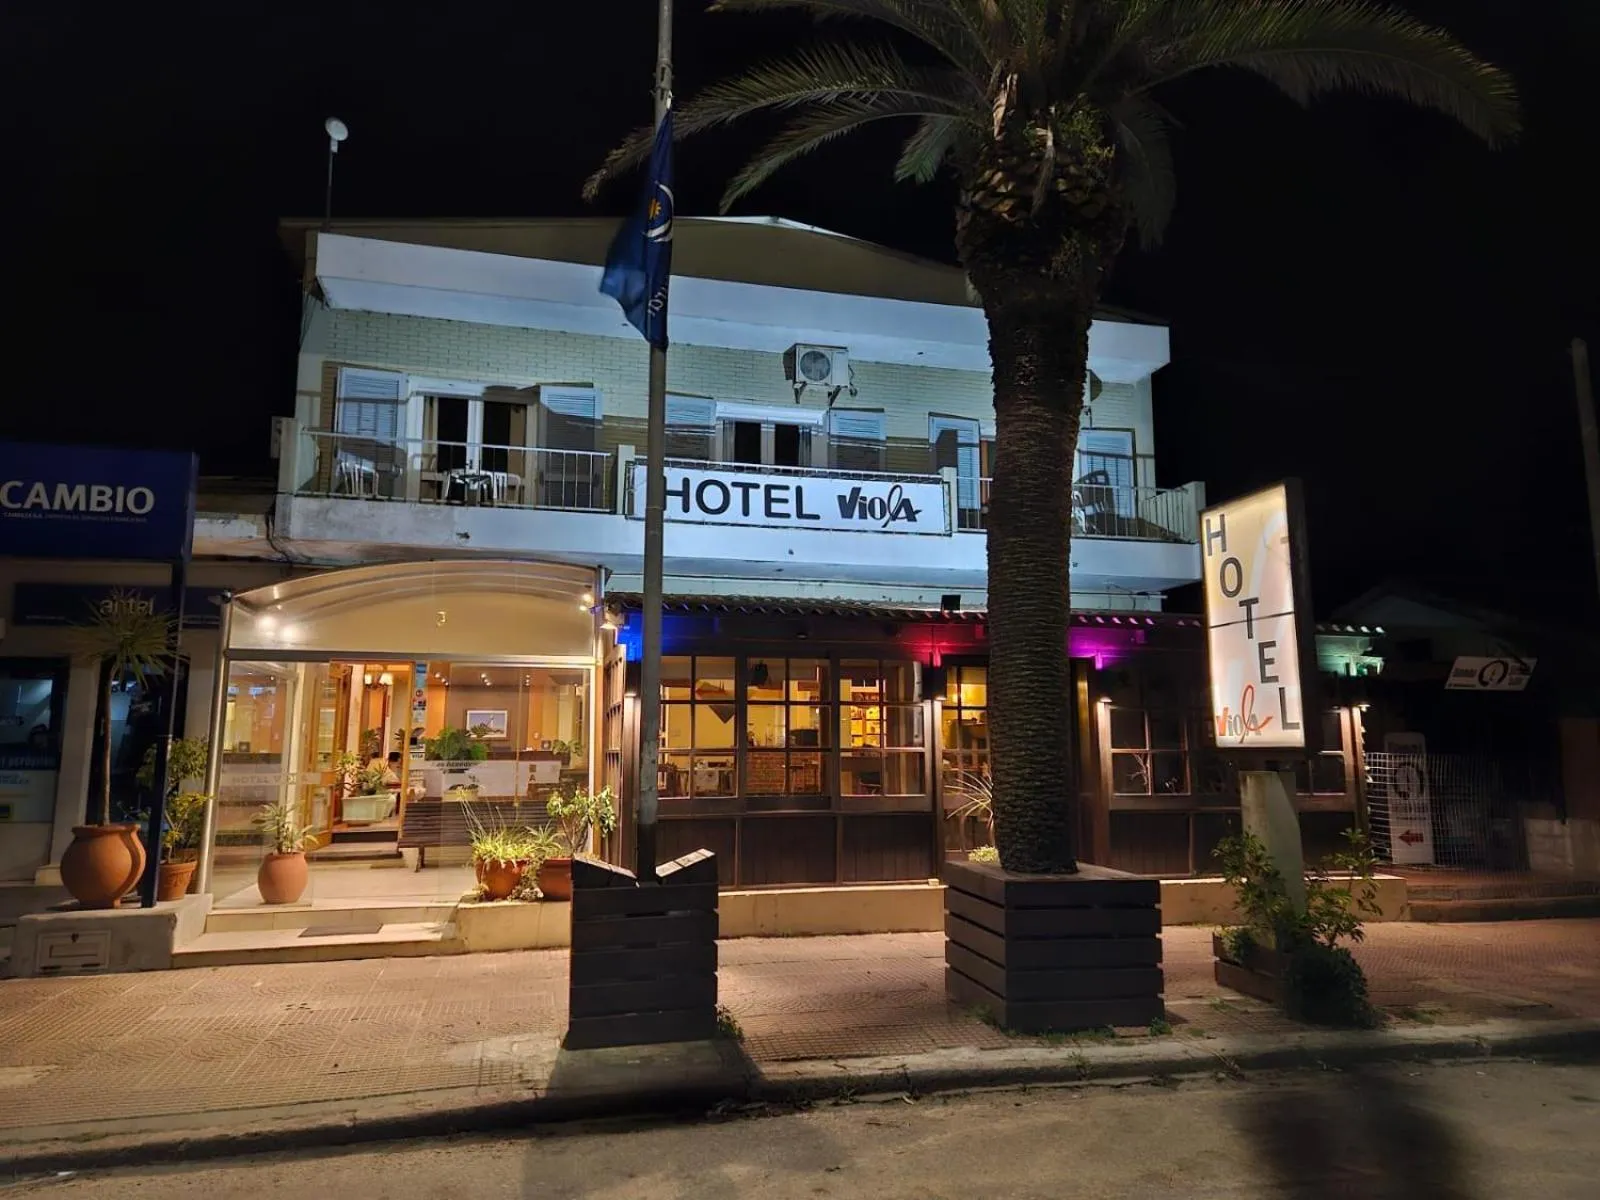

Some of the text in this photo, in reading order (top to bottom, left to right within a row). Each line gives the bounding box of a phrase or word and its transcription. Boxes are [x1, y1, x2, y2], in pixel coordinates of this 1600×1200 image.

[0, 480, 155, 515] CAMBIO
[664, 477, 820, 520] HOTEL
[1206, 514, 1300, 730] HOTEL
